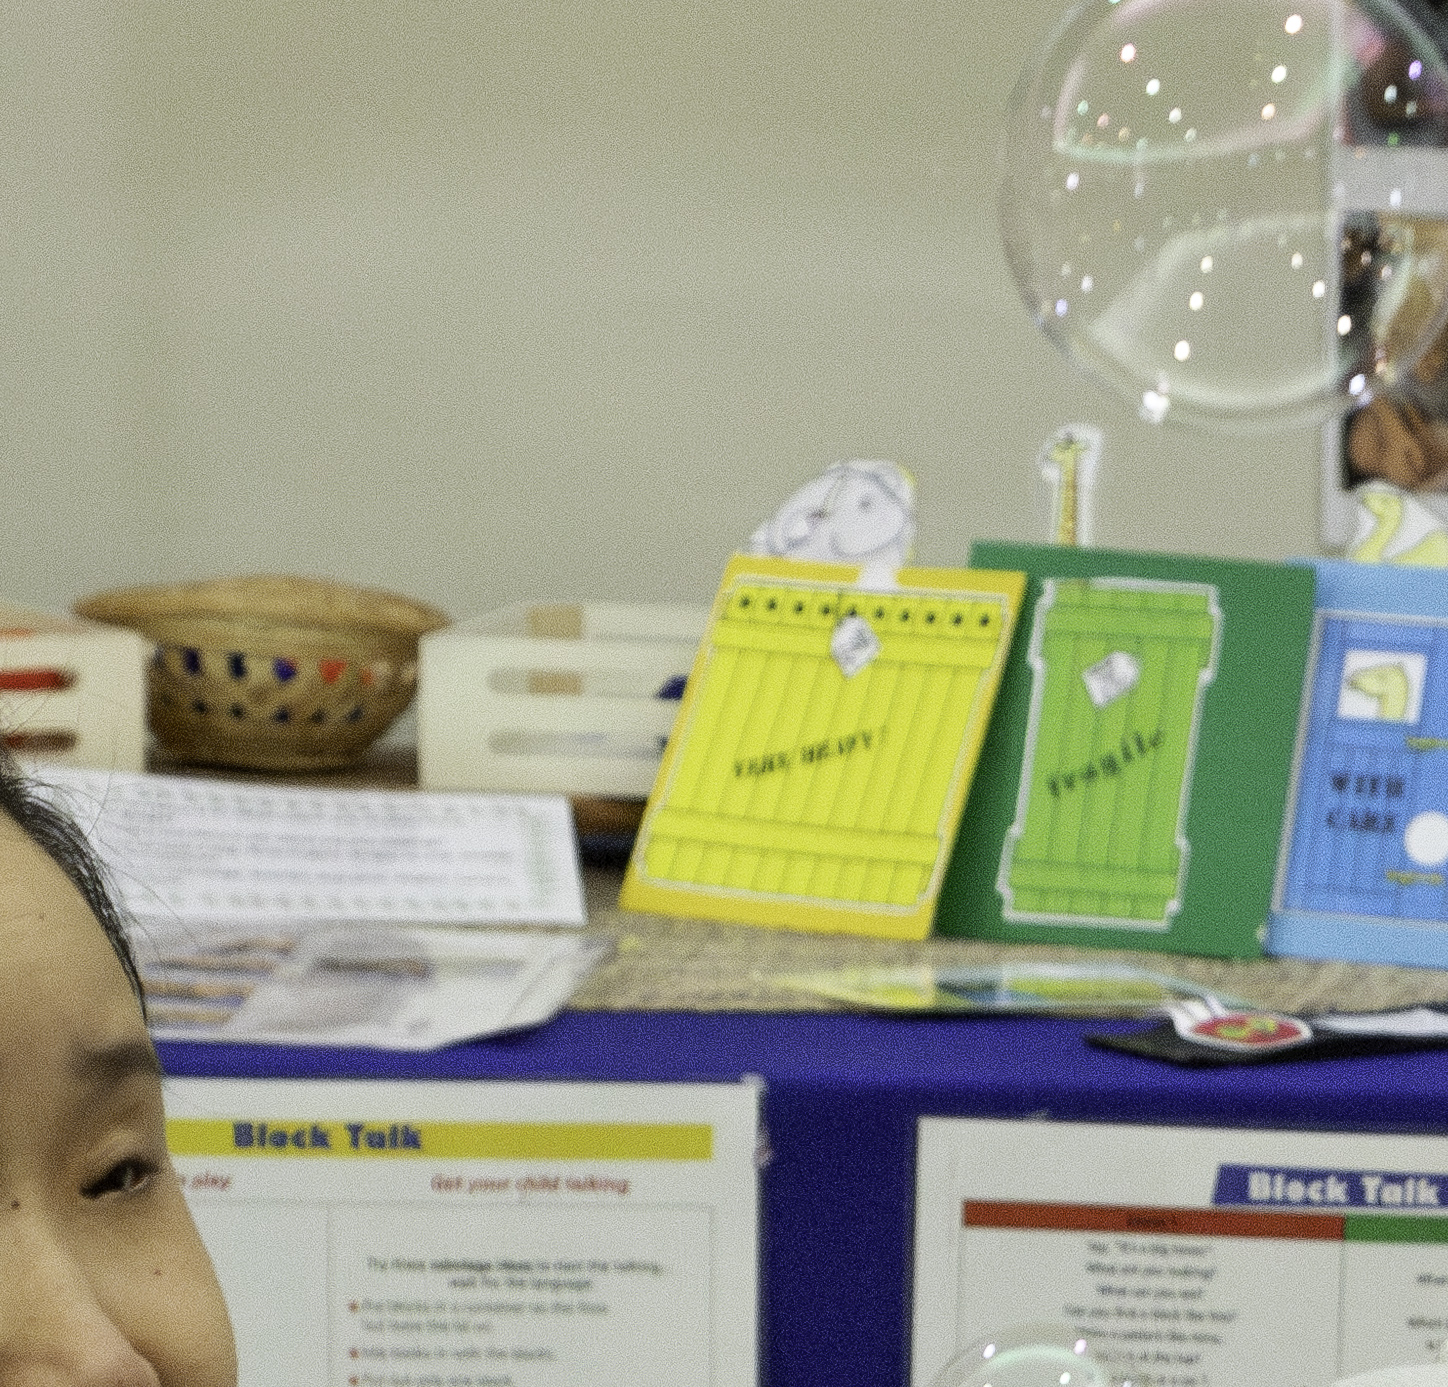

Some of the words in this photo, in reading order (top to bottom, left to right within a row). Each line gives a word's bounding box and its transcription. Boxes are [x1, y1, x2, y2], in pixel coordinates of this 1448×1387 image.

[233, 1121, 331, 1150] Block
[346, 1122, 422, 1150] Talk
[1247, 1169, 1349, 1204] Block
[1360, 1175, 1441, 1207] Talk
